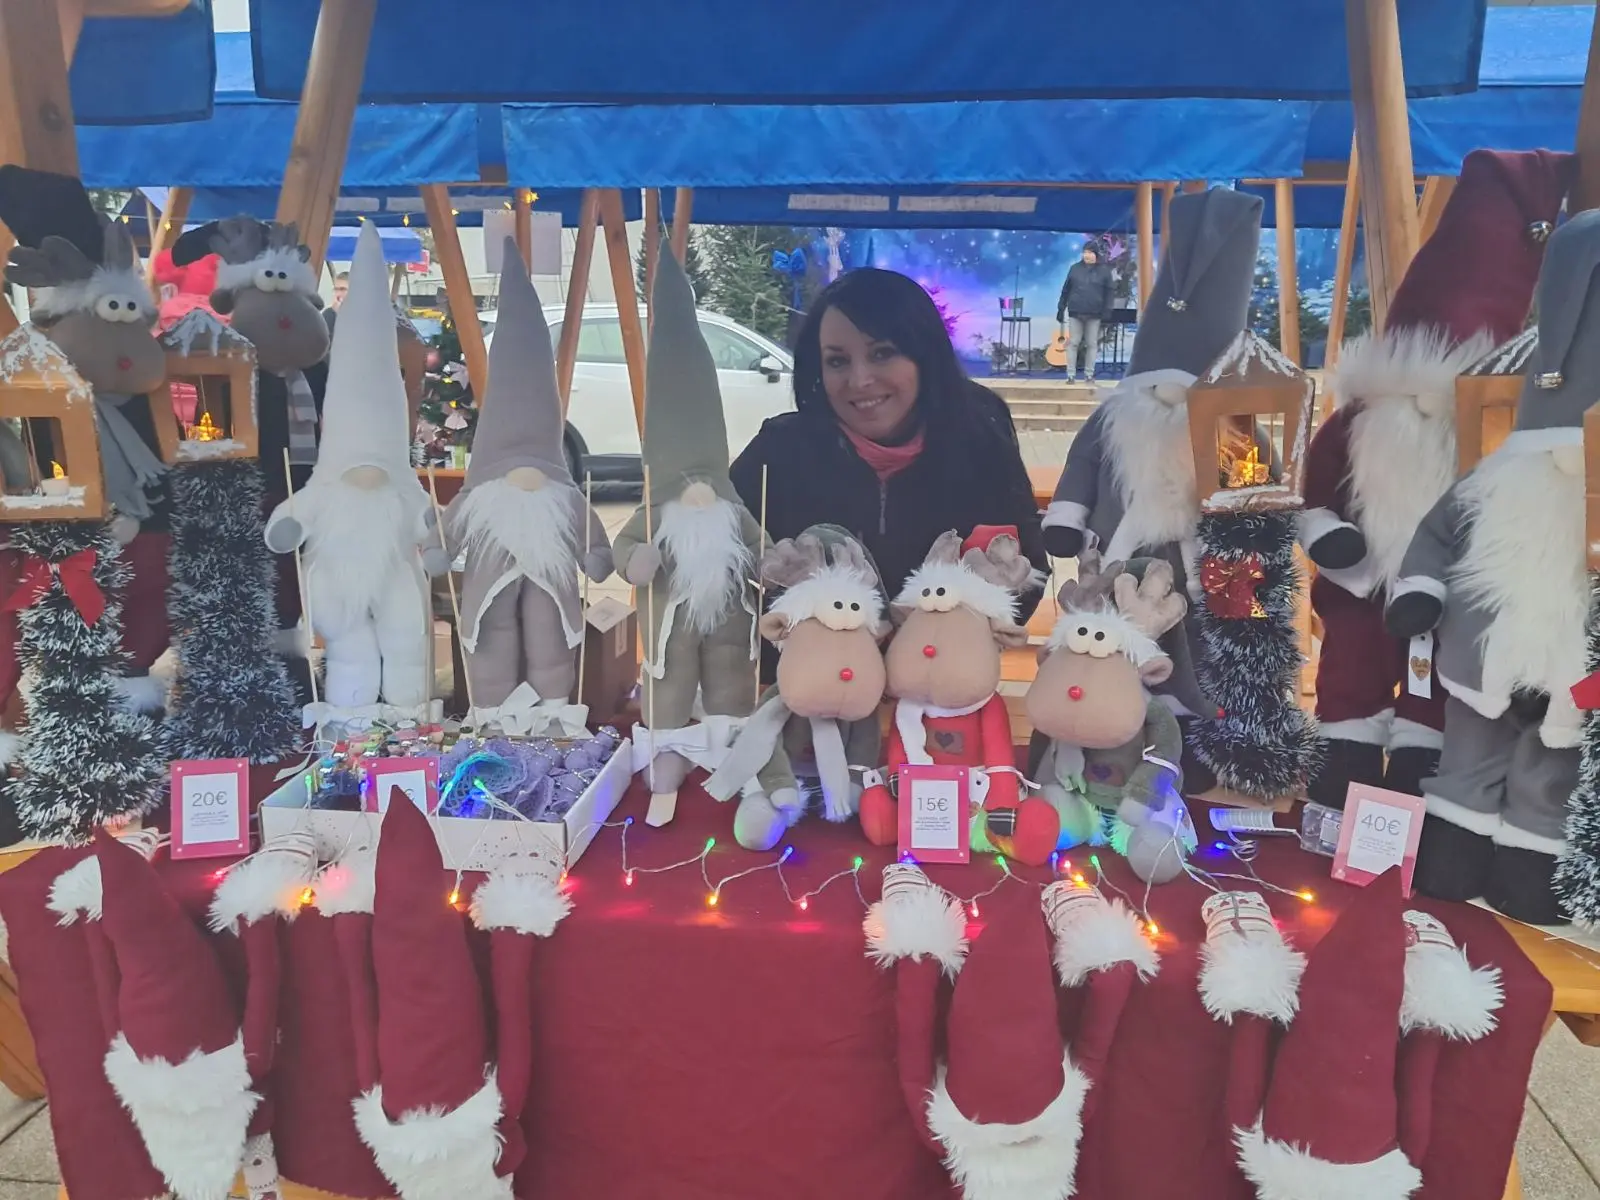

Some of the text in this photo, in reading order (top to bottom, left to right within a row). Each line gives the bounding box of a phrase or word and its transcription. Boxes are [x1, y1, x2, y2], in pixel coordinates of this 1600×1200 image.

[192, 791, 228, 807] 20€
[916, 797, 949, 812] 15€
[1361, 813, 1401, 836] 40€
